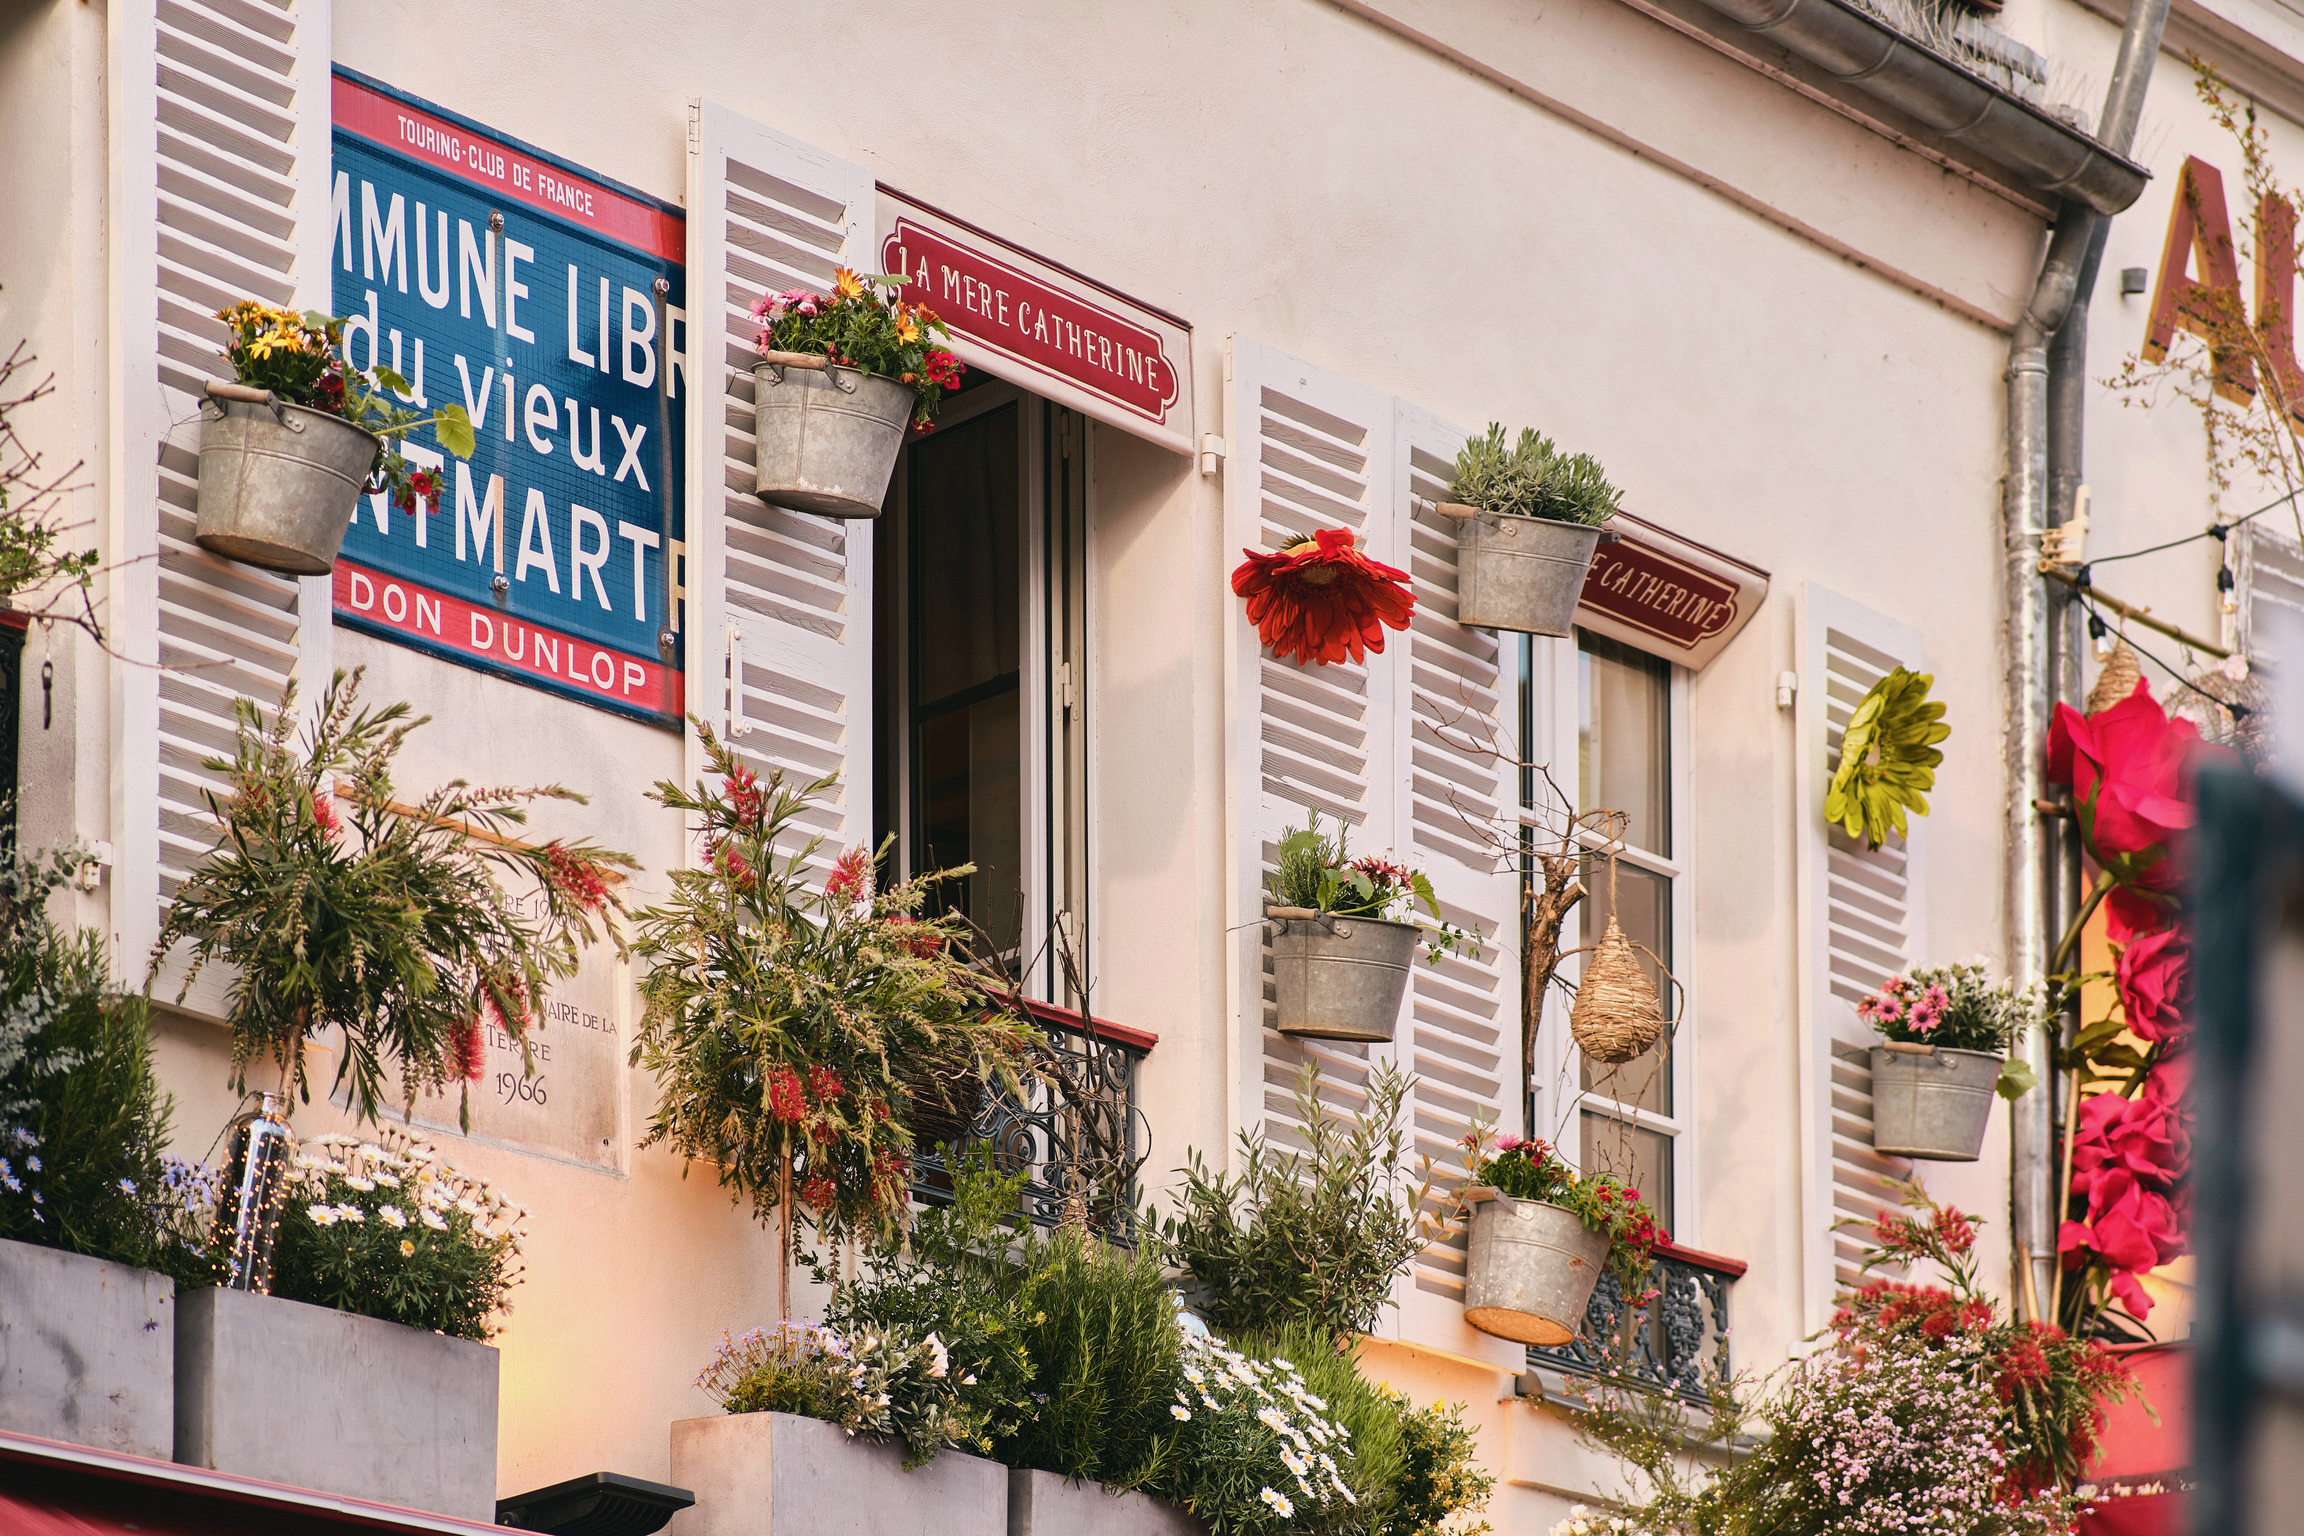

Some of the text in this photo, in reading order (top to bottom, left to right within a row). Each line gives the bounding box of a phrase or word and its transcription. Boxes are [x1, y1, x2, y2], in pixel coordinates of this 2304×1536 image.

[398, 115, 595, 217] TOURING-CLUB DE FRANCE
[899, 246, 1160, 392] LA MERE CATHERINE
[342, 289, 651, 492] du vieux
[351, 571, 646, 695] DON DUNLOP
[1600, 561, 1728, 630] CATHERINE
[486, 1024, 551, 1062] TERRE
[582, 1012, 599, 1030] DE
[602, 1018, 618, 1036] LA
[496, 1072, 547, 1106] 1966
